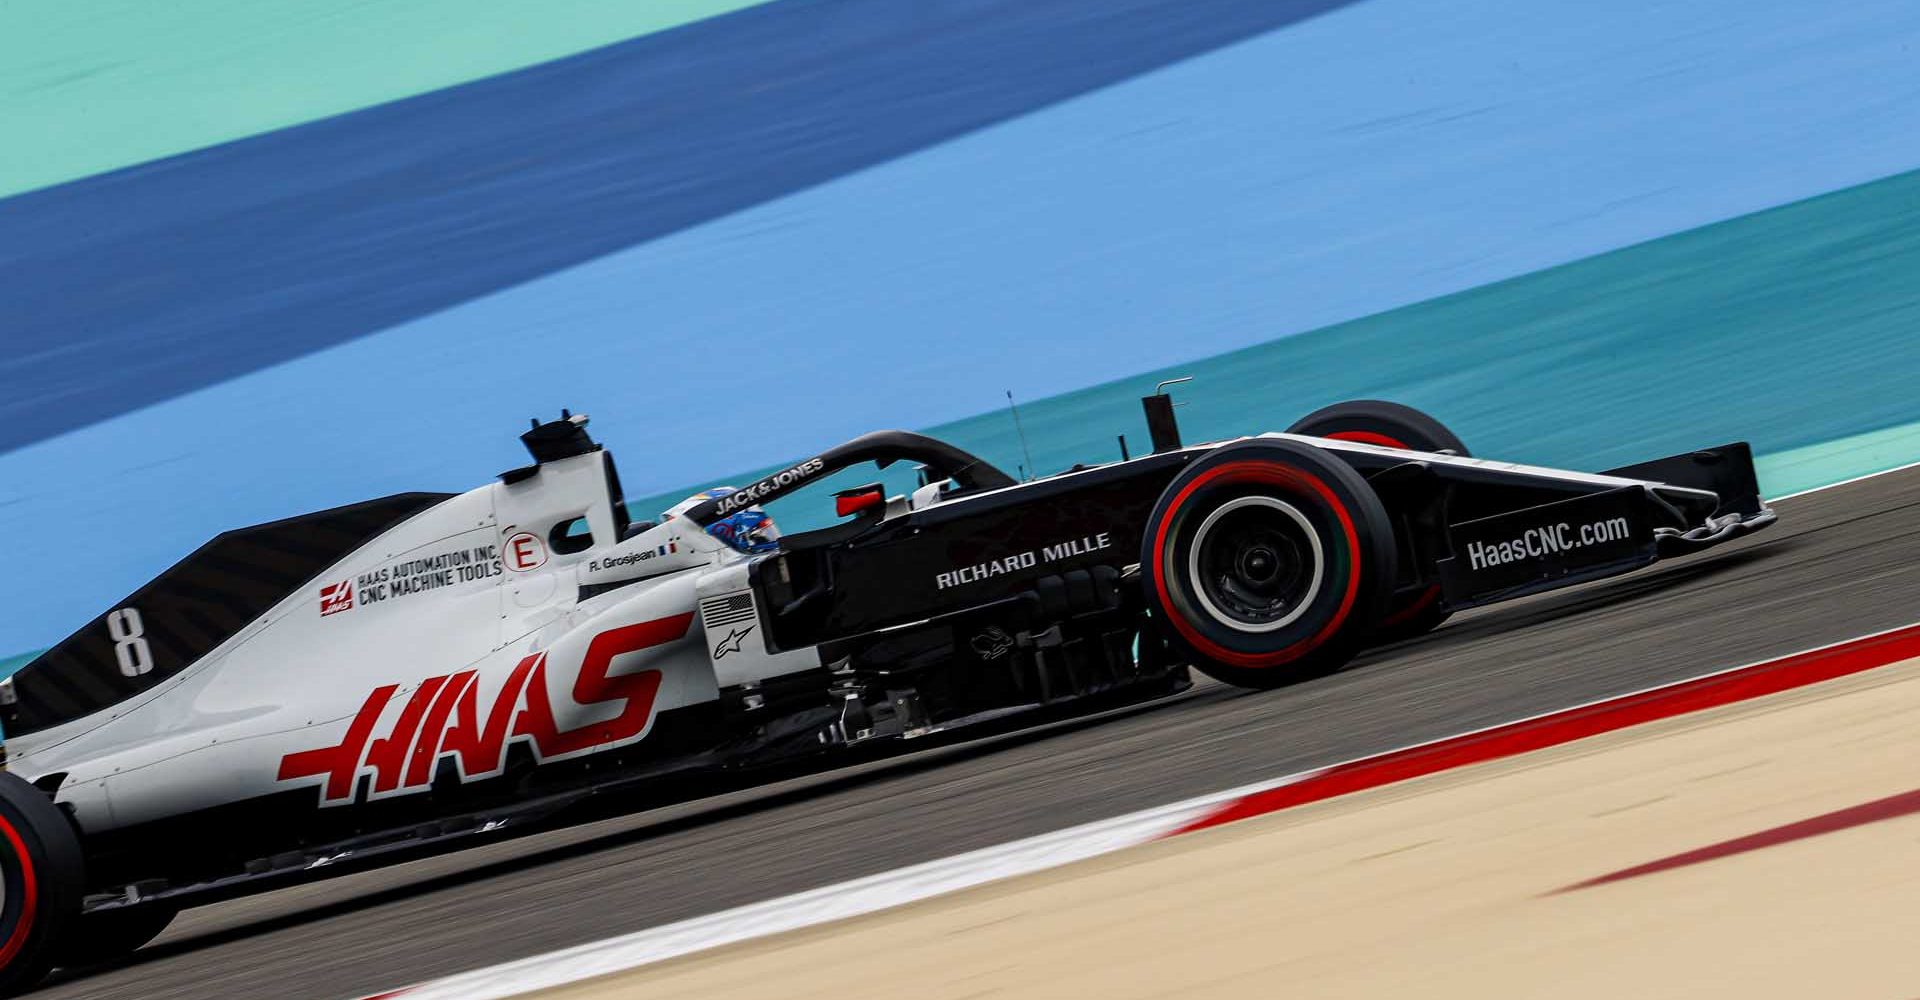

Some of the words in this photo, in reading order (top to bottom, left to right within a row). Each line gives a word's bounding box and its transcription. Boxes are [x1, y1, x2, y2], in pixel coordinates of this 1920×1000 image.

[715, 458, 824, 515] JACK&JONES
[358, 568, 389, 587] HAAS
[392, 549, 470, 579] AUTOMATION
[474, 545, 500, 561] INC.
[513, 537, 537, 568] E
[589, 561, 602, 572] R.
[603, 549, 656, 569] Grosjean
[936, 551, 1036, 589] RICHARD
[1042, 532, 1112, 563] MILLE
[1467, 517, 1630, 571] HaasCNC.com
[359, 585, 386, 605] CNC
[391, 570, 454, 598] MACHINE
[459, 560, 503, 582] TOOLS
[107, 607, 154, 676] 8
[277, 610, 697, 801] HAAS
